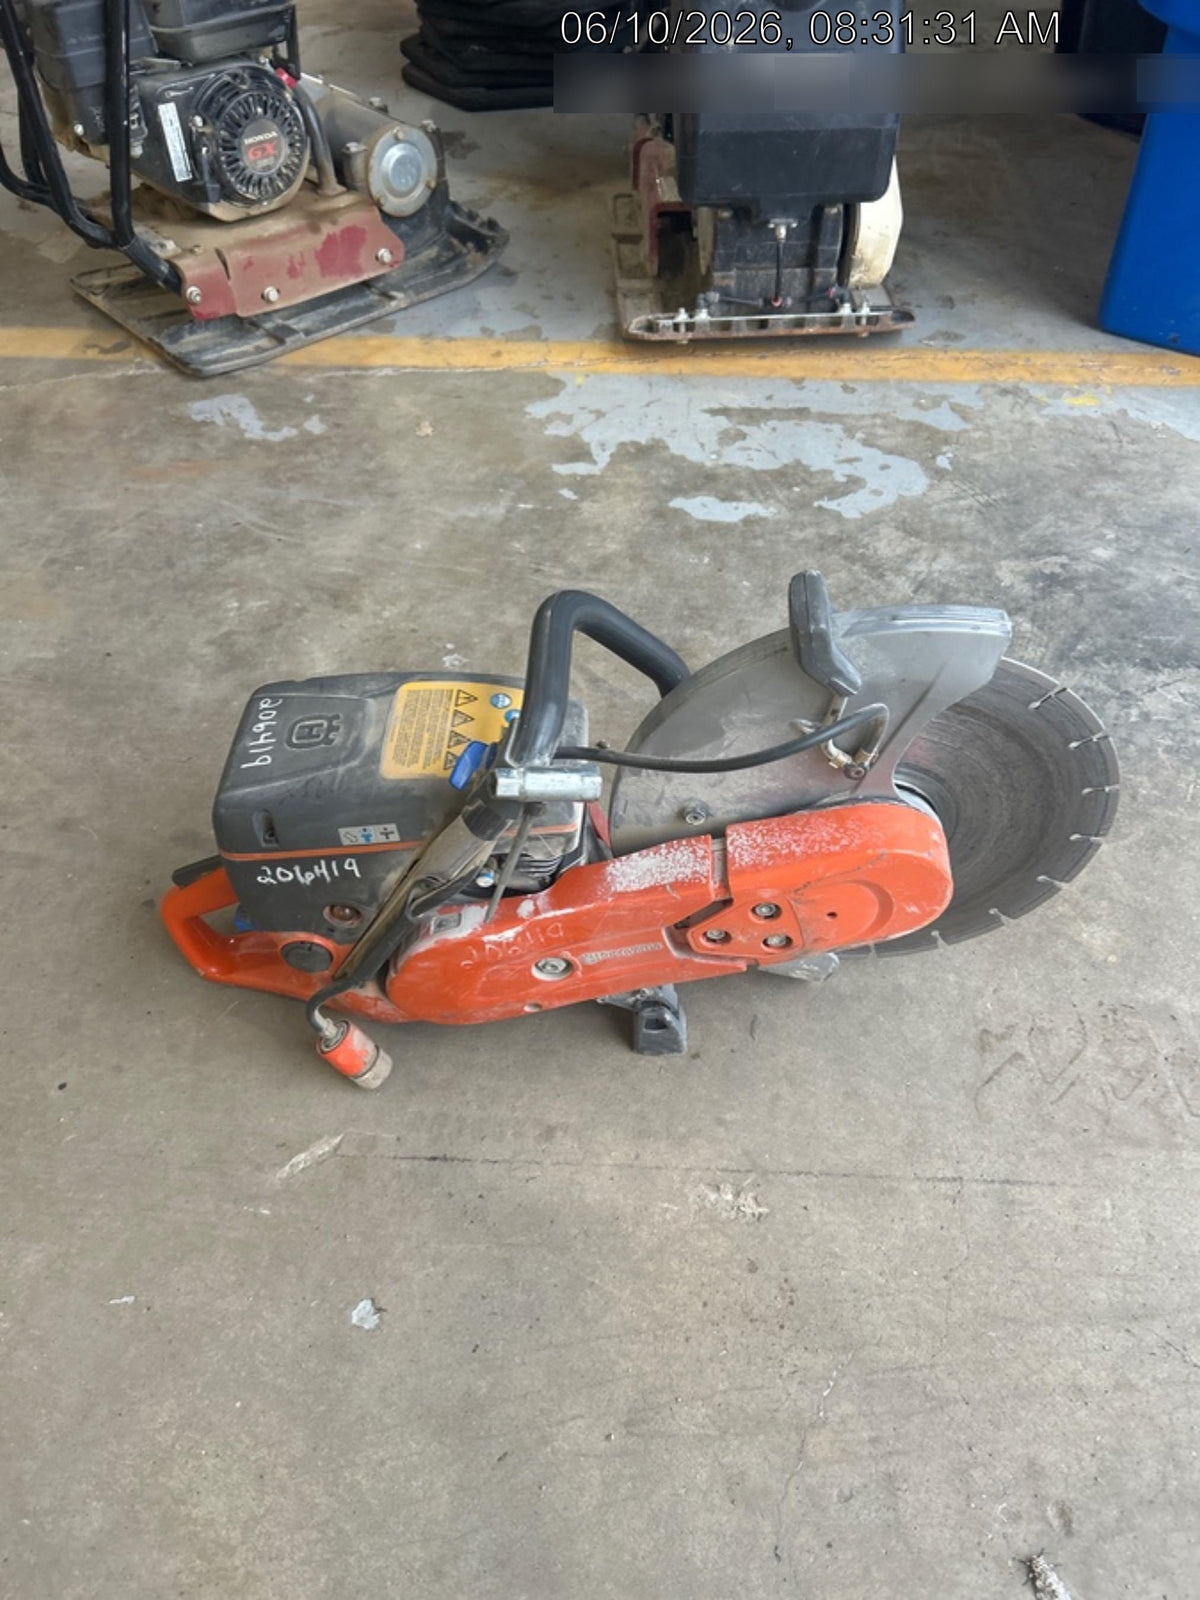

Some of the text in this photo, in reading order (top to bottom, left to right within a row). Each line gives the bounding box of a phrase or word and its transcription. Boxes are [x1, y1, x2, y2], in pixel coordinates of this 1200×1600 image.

[243, 130, 279, 145] HONDA
[247, 142, 277, 161] GX
[240, 697, 284, 769] 206419
[256, 857, 362, 886] 206419
